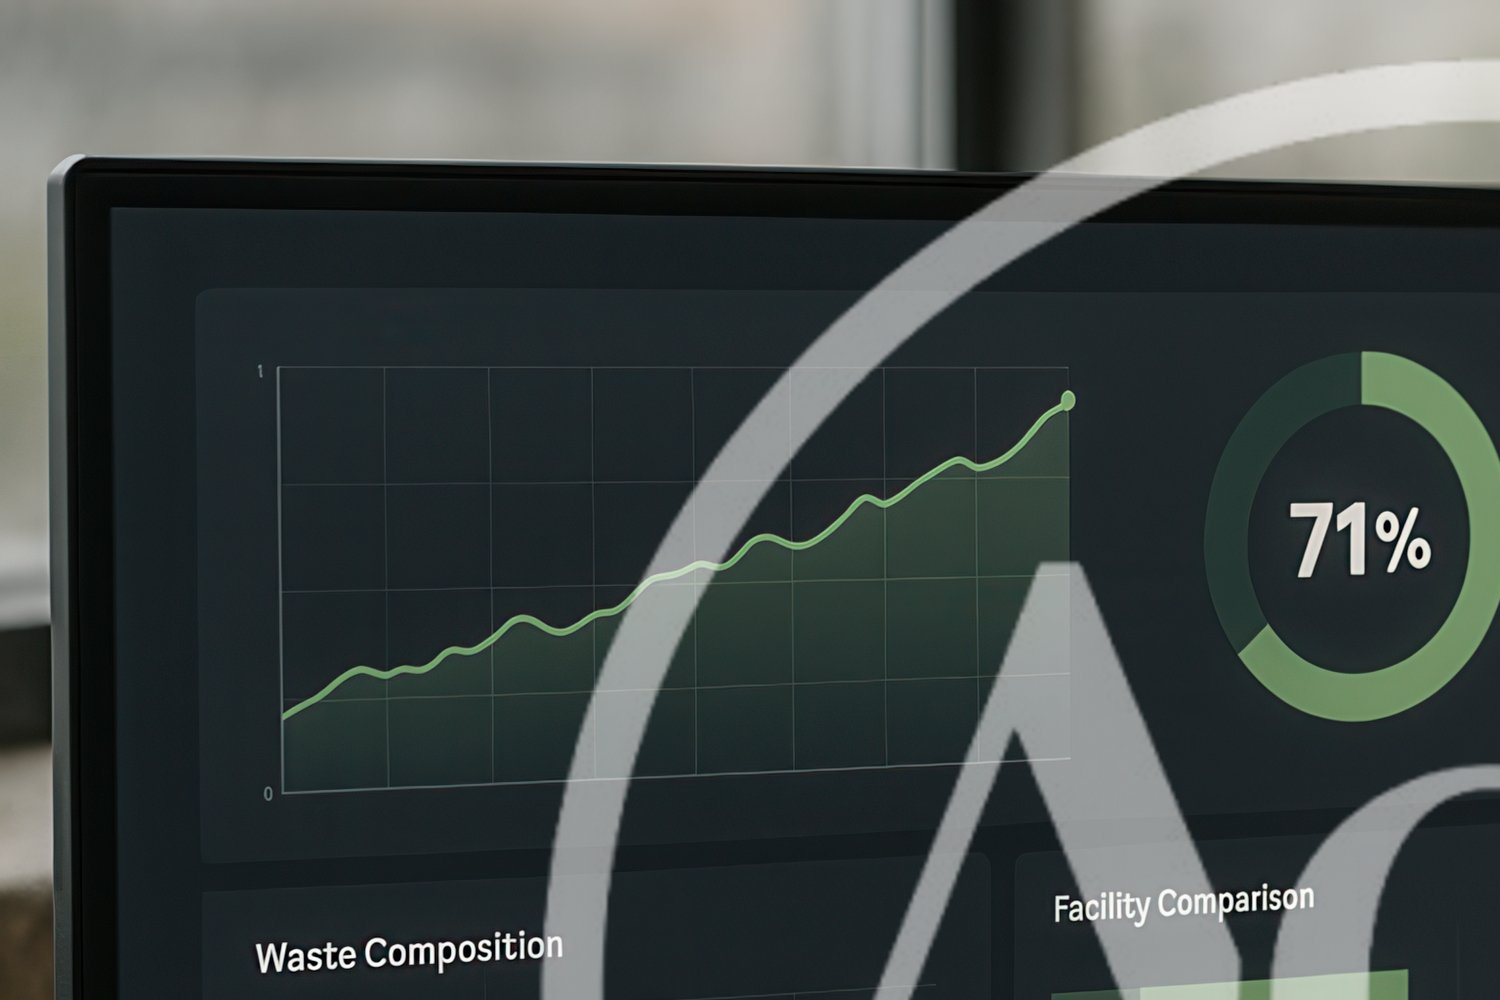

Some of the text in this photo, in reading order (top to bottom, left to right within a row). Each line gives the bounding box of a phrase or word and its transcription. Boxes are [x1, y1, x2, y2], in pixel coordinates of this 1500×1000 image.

[1289, 501, 1432, 578] 71%
[263, 785, 274, 802] 0
[1054, 883, 1315, 928] Facility Comparison
[255, 930, 564, 974] Waste Composition
